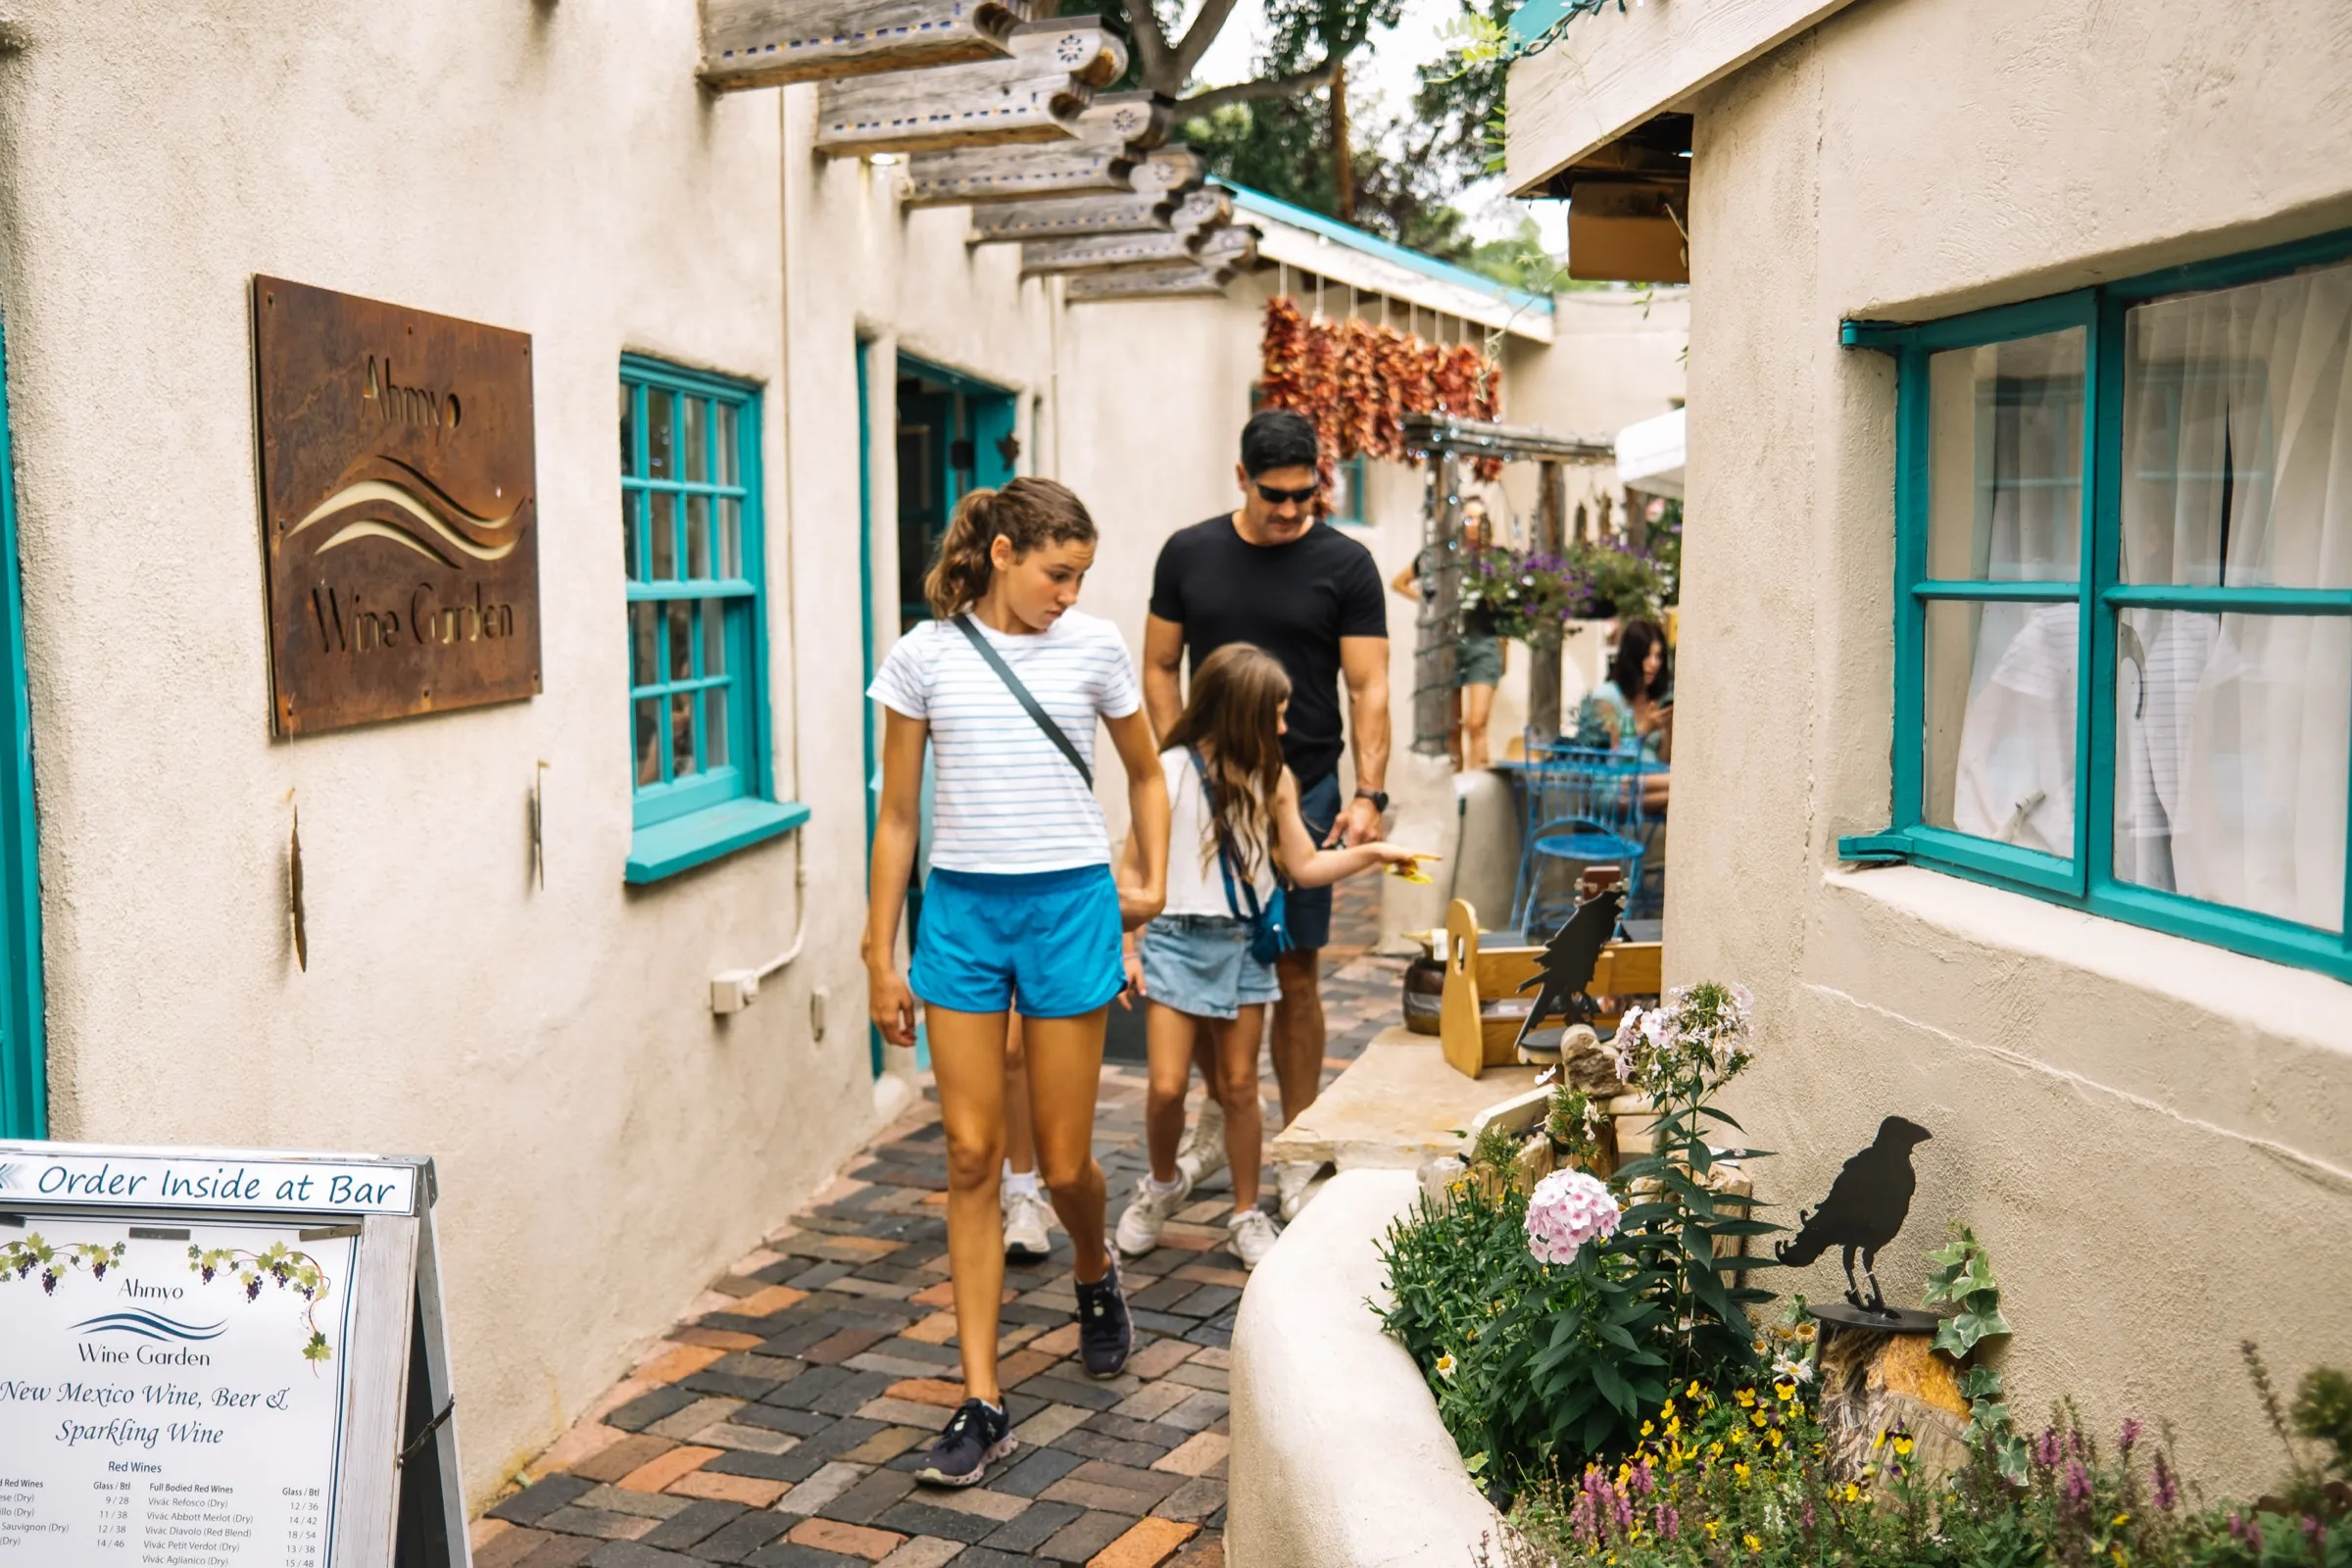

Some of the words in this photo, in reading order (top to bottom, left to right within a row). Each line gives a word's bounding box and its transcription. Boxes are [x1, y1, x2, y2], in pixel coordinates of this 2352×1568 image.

[362, 354, 462, 447] Ahmyo
[312, 585, 400, 655] Wine
[410, 582, 514, 646] Garden
[38, 1163, 147, 1197] Order
[161, 1168, 261, 1200] Inside
[275, 1174, 314, 1201] at
[329, 1175, 395, 1204] Bar
[118, 1279, 184, 1305] Ahmyo
[77, 1343, 129, 1365] Wine
[136, 1345, 211, 1367] Garden
[0, 1381, 52, 1402] New
[56, 1382, 134, 1408] Mexico
[142, 1383, 203, 1409] Wine,
[211, 1387, 262, 1408] Beer
[266, 1387, 291, 1411] &
[55, 1418, 160, 1449] Sparkling
[167, 1421, 224, 1445] Wine
[108, 1460, 128, 1473] Red
[130, 1461, 163, 1475] Wines
[5, 1479, 20, 1488] Red
[21, 1479, 44, 1489] Wines
[93, 1481, 114, 1491] Glass
[120, 1482, 131, 1491] Btl
[149, 1483, 165, 1492] Full
[165, 1483, 193, 1493] Bodied
[194, 1484, 210, 1494] Red
[211, 1485, 234, 1494] Wines
[282, 1487, 303, 1496] Glass
[309, 1488, 320, 1496] Btl
[14, 1493, 34, 1504] (Dry)
[14, 1507, 34, 1518] (Dry)
[48, 1523, 70, 1534] (Dry)
